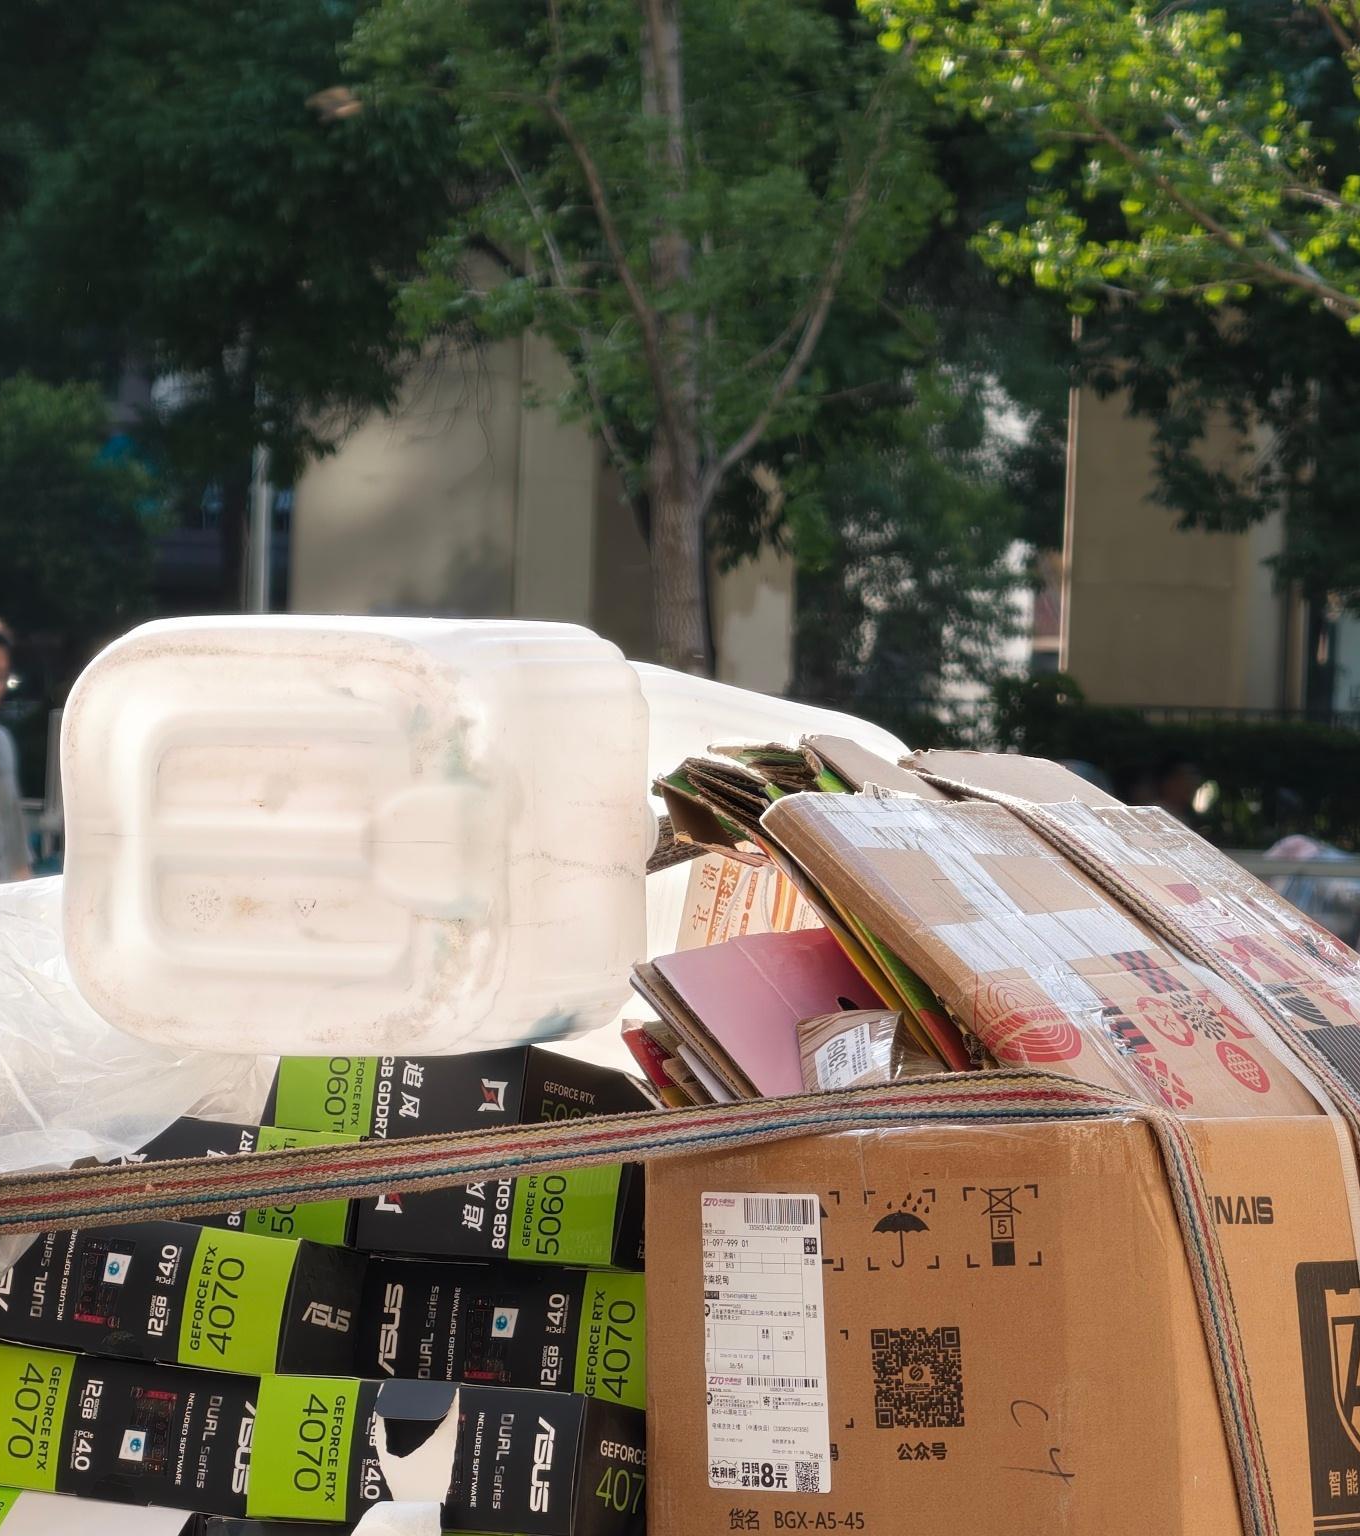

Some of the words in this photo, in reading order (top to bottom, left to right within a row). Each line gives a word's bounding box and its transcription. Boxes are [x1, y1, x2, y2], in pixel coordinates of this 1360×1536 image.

[373, 1080, 392, 1139] GDDR7
[399, 1060, 425, 1119] 追风
[543, 1080, 580, 1104] GEFORCE
[579, 1091, 596, 1106] RTX
[350, 1103, 360, 1126] RTX
[491, 1213, 508, 1249] 8GB
[522, 1192, 537, 1247] GEFORCE
[536, 1175, 567, 1256] 5060
[997, 1220, 1007, 1235] 5
[1209, 1196, 1274, 1225] NAIS
[30, 1271, 49, 1318] DUAL
[56, 1274, 69, 1321] INCLUDED
[64, 1229, 79, 1274] SOFTWARE
[147, 1295, 168, 1336] 12GB
[158, 1244, 178, 1274] 4.0
[190, 1279, 209, 1351] GEFORCE
[202, 1245, 218, 1275] RTX
[206, 1257, 245, 1355] 4070
[302, 1301, 352, 1333] ASUS
[425, 1285, 440, 1328] Series
[449, 1287, 462, 1334] SOFTWARE
[547, 1293, 566, 1326] 4.0
[592, 1290, 607, 1320] RTX
[378, 1283, 404, 1376] ASUS
[602, 1300, 636, 1398] 4070
[418, 1333, 435, 1380] DUAL
[446, 1335, 457, 1380] INCLUDED
[540, 1345, 561, 1386] 12GB
[585, 1323, 603, 1397] GEFORCE
[7, 1362, 45, 1459] 4070
[40, 1366, 62, 1437] GEFORCE
[81, 1379, 104, 1420] 12GB
[183, 1392, 196, 1435] INCLUDED
[202, 1395, 223, 1441] DUAL
[75, 1438, 92, 1471] 4.0
[293, 1393, 328, 1492] 4070
[326, 1395, 346, 1468] GEFORCE
[474, 1411, 486, 1456] INCLUDED
[495, 1413, 515, 1461] DUAL
[897, 1442, 948, 1461] 公众号
[36, 1440, 48, 1470] RTX
[175, 1436, 187, 1486] SOFTWARE
[196, 1446, 211, 1489] Series
[529, 1416, 556, 1513] ASUS
[741, 1462, 760, 1474] 扫码
[324, 1469, 336, 1502] RTX
[364, 1467, 381, 1500] 4.0
[470, 1457, 482, 1508] SOFTWARE
[492, 1465, 506, 1510] Series
[596, 1466, 645, 1515] 407
[728, 1508, 760, 1531] 货名
[774, 1511, 865, 1530] BGX-A5-45
